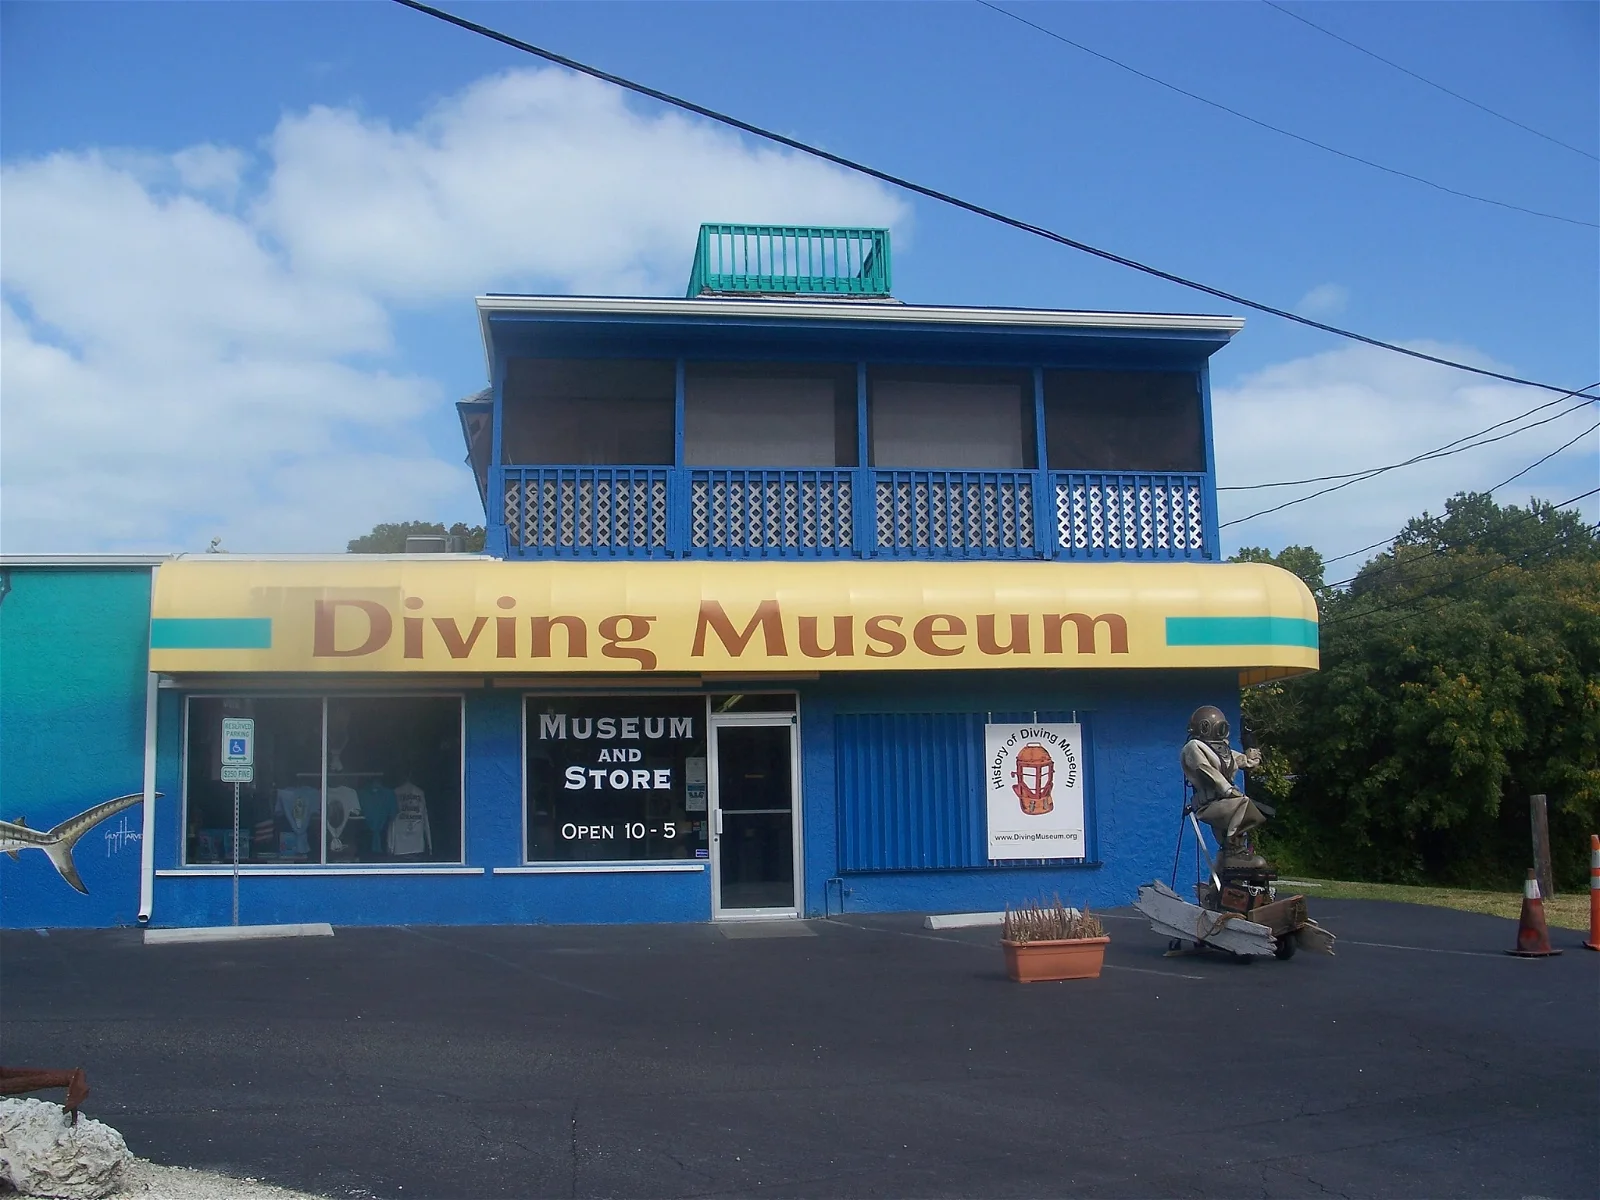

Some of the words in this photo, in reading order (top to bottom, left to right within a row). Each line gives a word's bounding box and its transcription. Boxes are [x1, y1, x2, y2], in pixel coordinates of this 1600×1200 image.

[313, 596, 657, 670] Diving
[690, 599, 1130, 658] Museum
[539, 713, 693, 740] MUSEUM
[598, 748, 642, 763] AND
[991, 745, 1009, 790] History
[1007, 733, 1017, 747] of
[1020, 727, 1059, 744] Diving
[1058, 738, 1077, 788] Museum
[224, 770, 237, 778] $250
[238, 770, 251, 778] FINE
[564, 765, 671, 790] STORE
[561, 823, 614, 839] OPEN
[994, 833, 1078, 841] www.DivingMuseum.org
